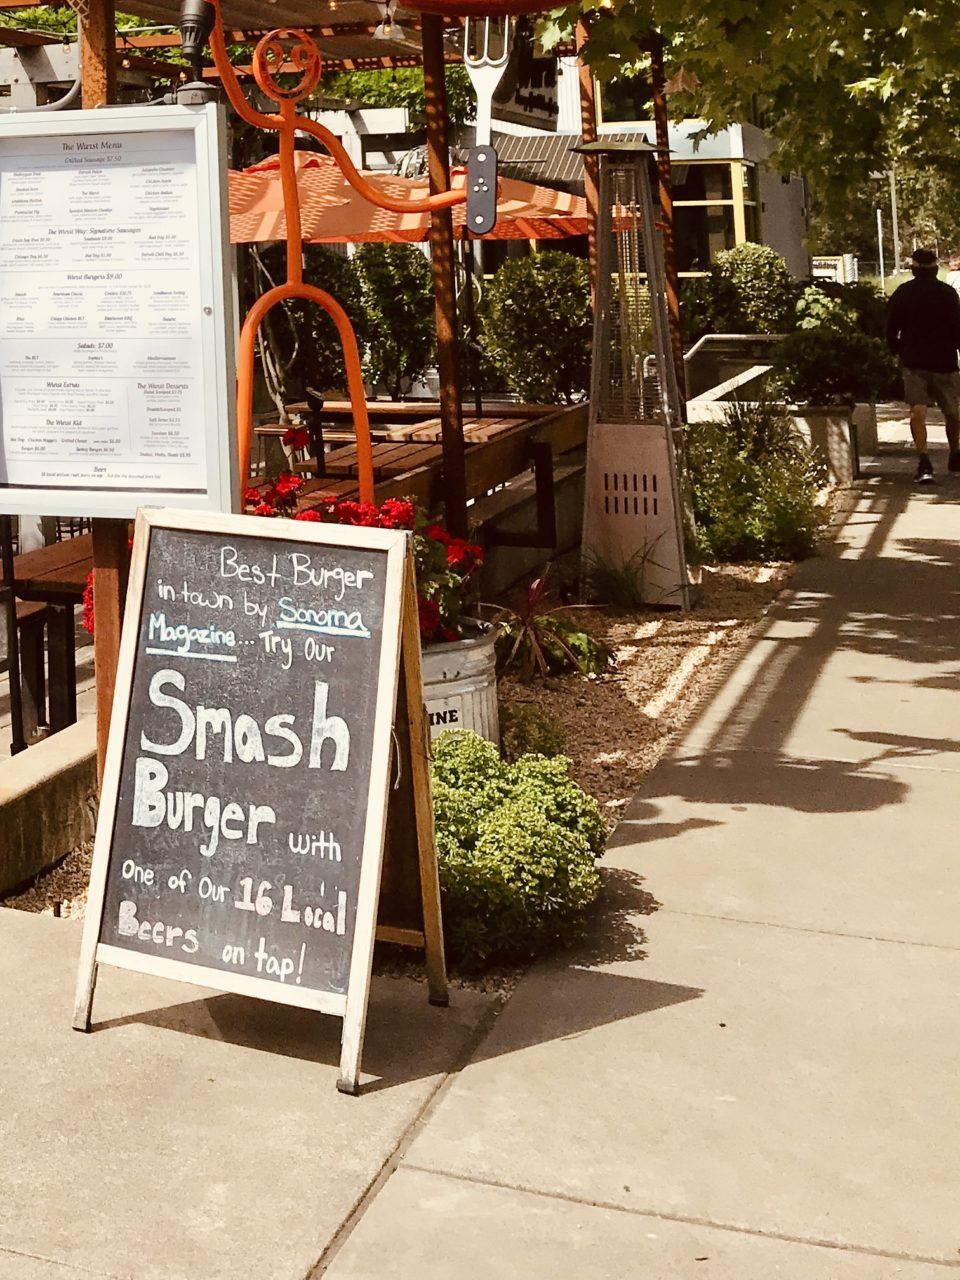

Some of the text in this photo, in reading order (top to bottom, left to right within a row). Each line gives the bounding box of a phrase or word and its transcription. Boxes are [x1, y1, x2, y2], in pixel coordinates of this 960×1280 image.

[62, 141, 123, 151] The Wurst Menu
[220, 546, 374, 602] Best Burger
[181, 581, 234, 611] town
[243, 591, 269, 628] by
[276, 597, 369, 632] Sonoma
[258, 630, 292, 670] Try
[140, 668, 352, 772] Smash
[428, 709, 459, 726] INE
[131, 757, 342, 862] Burger with
[167, 868, 193, 894] of
[234, 876, 274, 917] 16
[280, 884, 348, 936] Local
[117, 899, 307, 986] Beers on tap!
